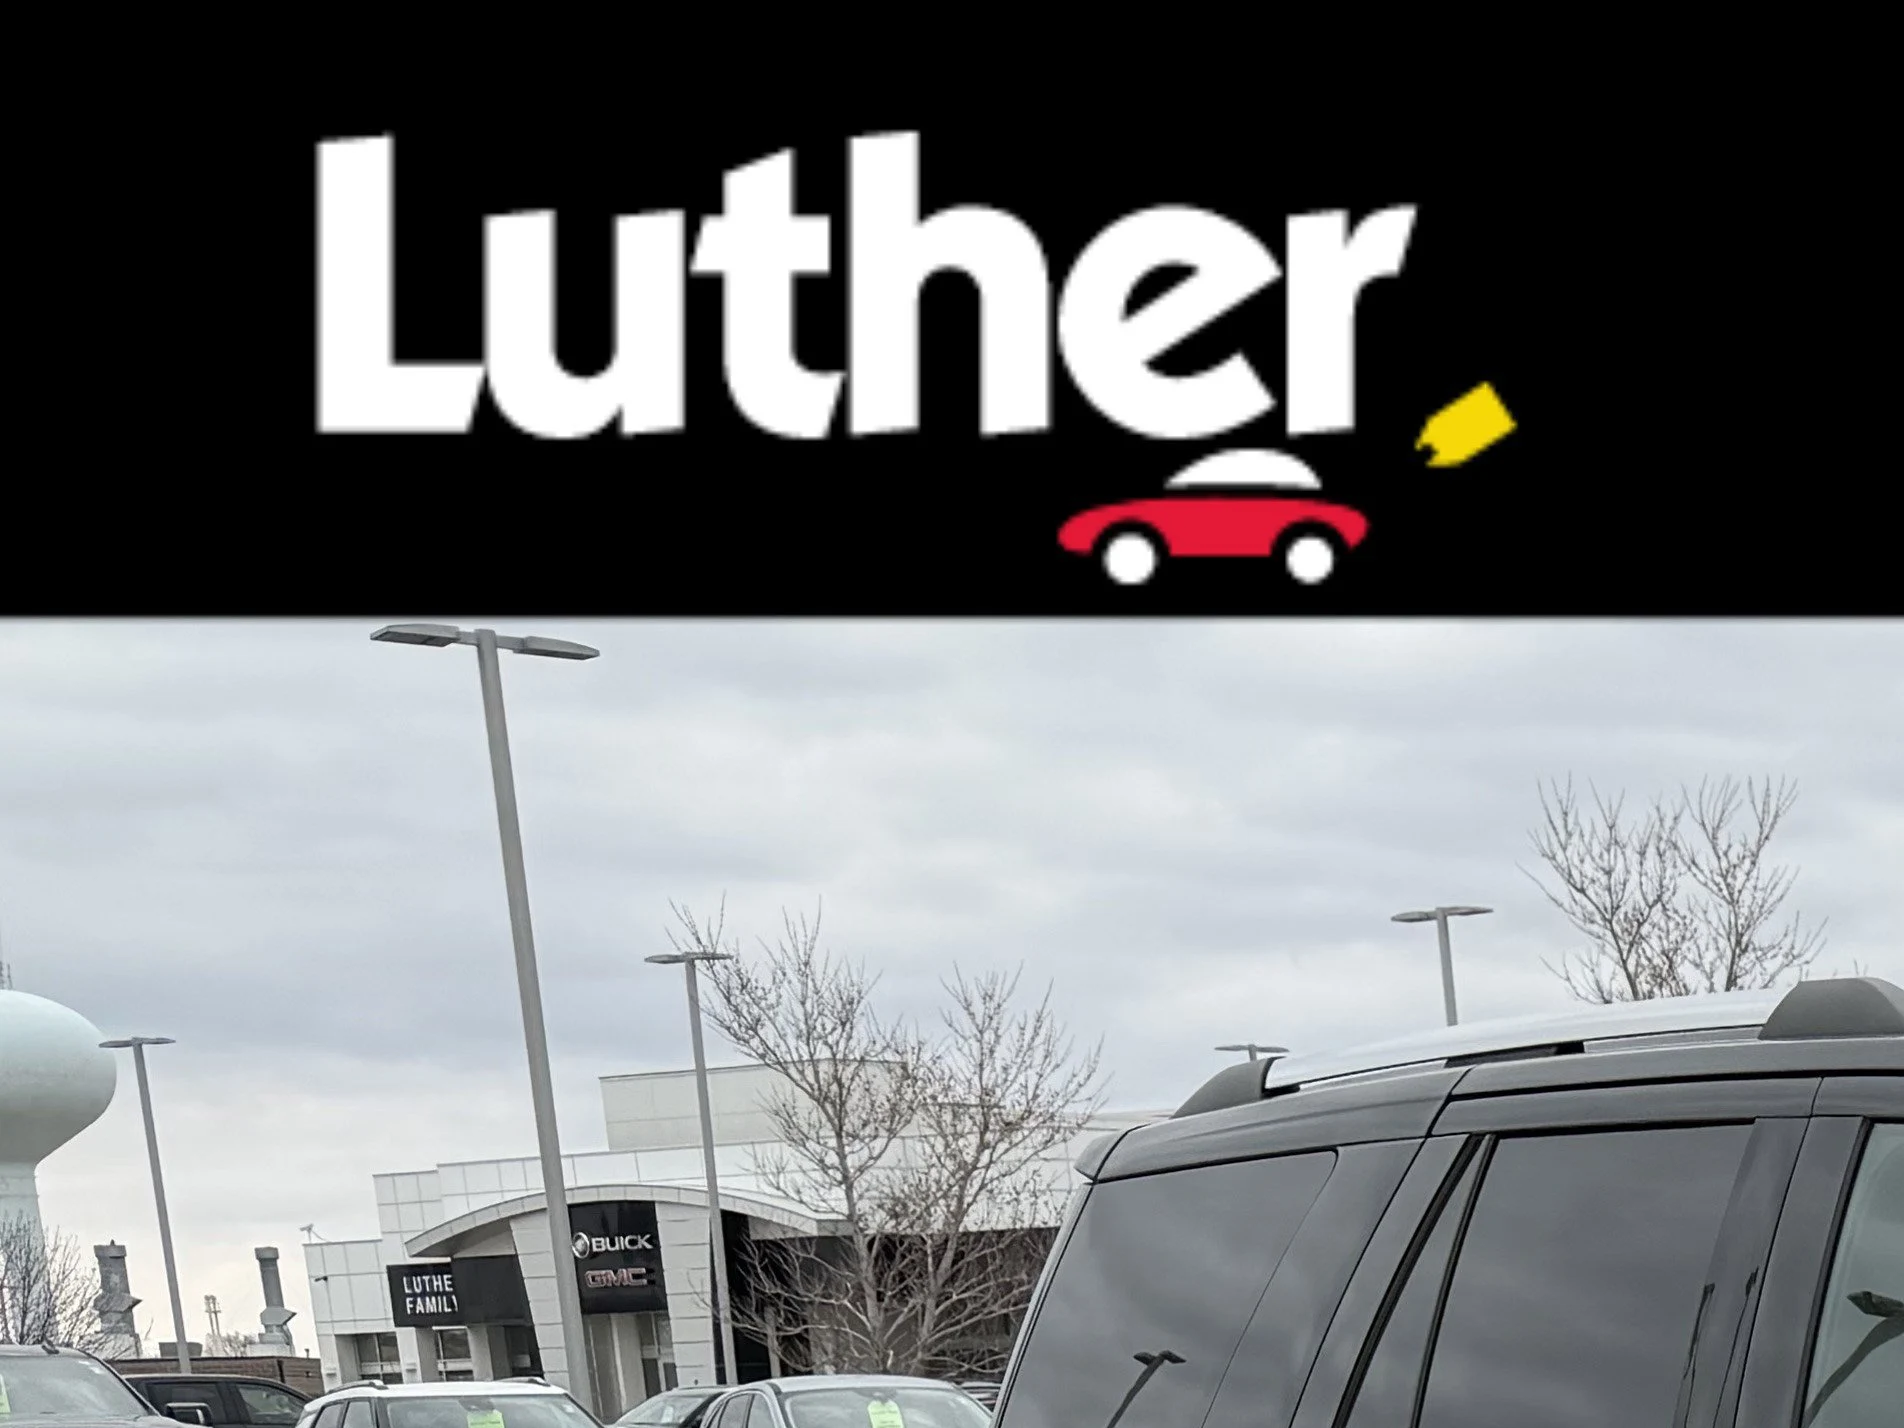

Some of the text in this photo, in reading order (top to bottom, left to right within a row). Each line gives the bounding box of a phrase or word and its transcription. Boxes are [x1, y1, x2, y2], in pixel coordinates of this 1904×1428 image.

[591, 1234, 654, 1253] BUICK
[403, 1274, 453, 1293] LUTHE
[584, 1267, 650, 1288] GMC
